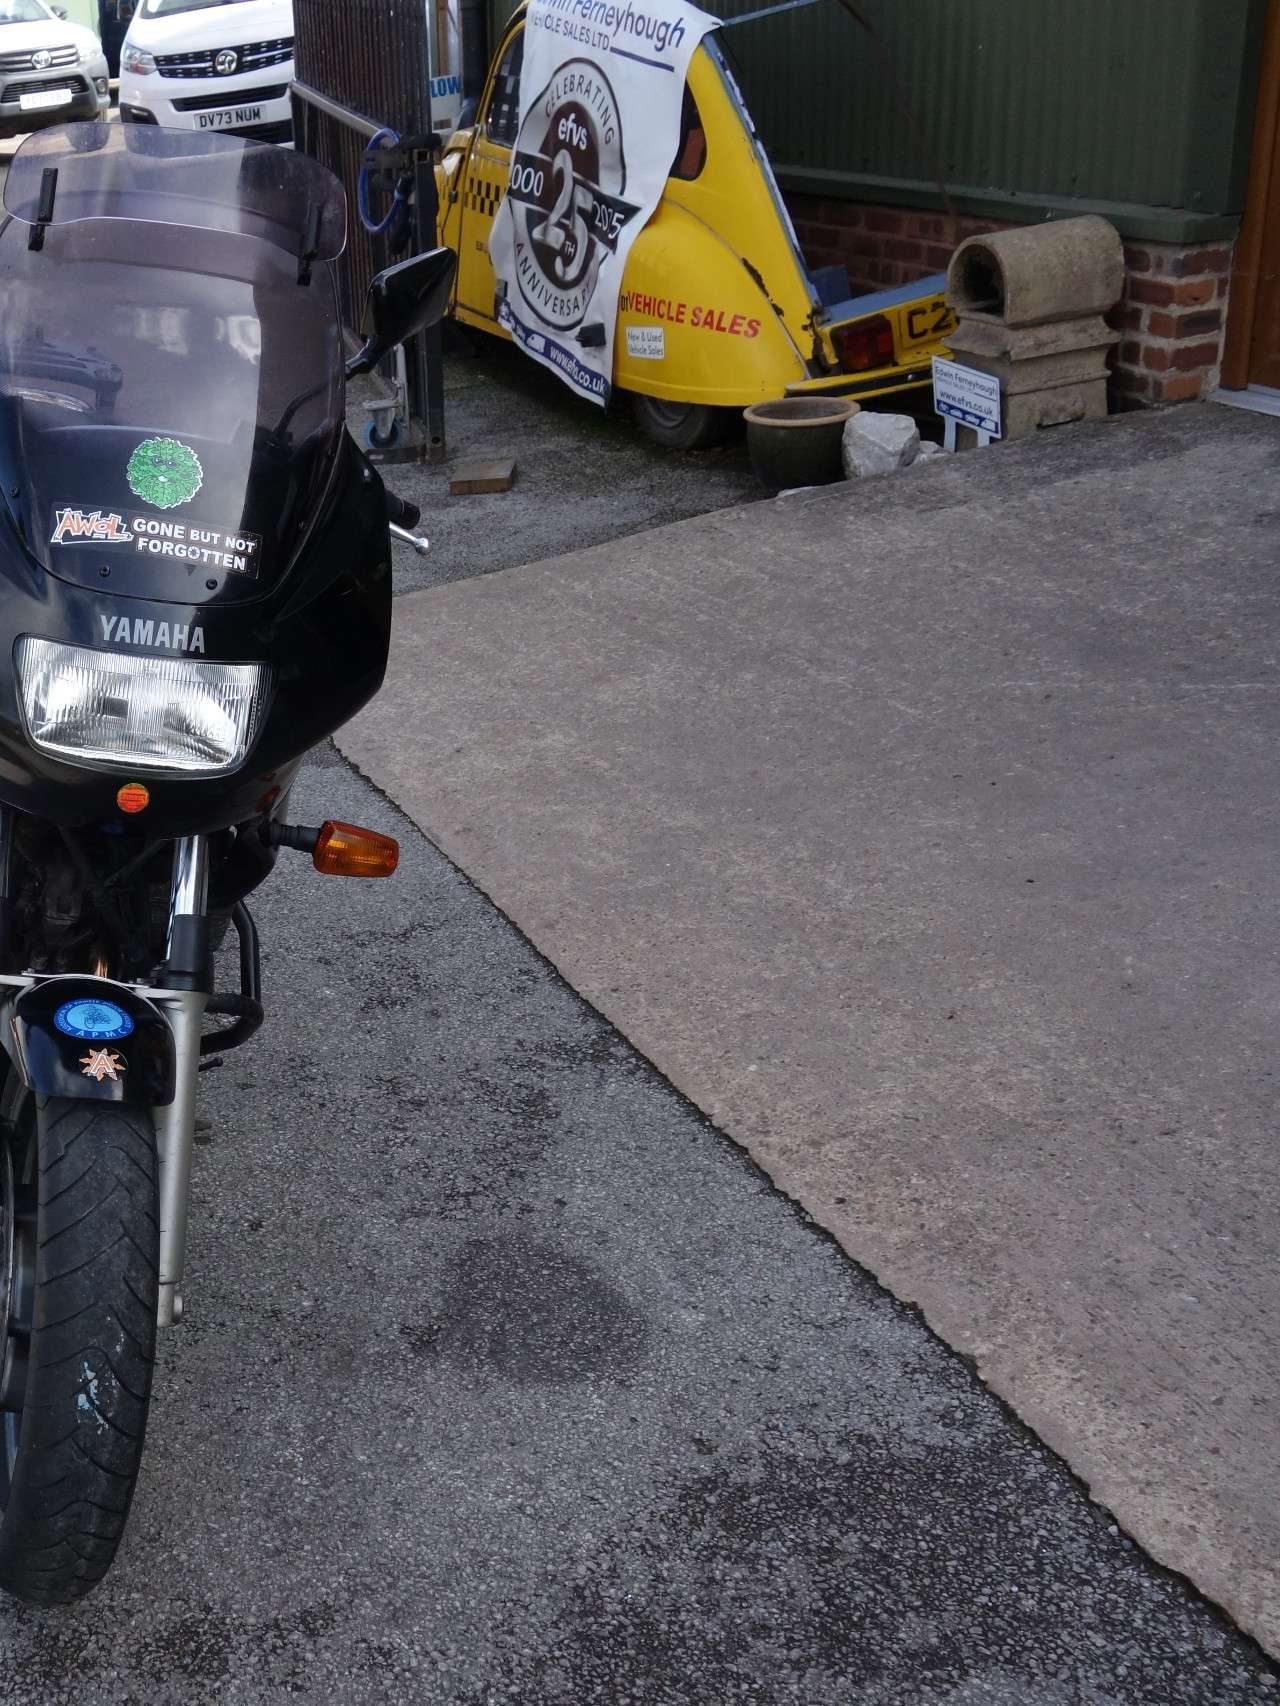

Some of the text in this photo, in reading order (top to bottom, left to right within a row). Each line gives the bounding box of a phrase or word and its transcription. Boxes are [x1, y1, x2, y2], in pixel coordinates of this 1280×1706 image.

[563, 20, 590, 44] SALES
[592, 31, 610, 50] LTD
[199, 107, 261, 128] DV73 NUM
[545, 74, 615, 145] CELEBRATING
[558, 113, 588, 150] efvs
[512, 164, 544, 197] 000
[564, 240, 576, 258] TH
[628, 290, 687, 324] VEHICLE
[690, 306, 762, 338] SALES
[940, 391, 993, 415] www.efvs.co.uk
[133, 518, 186, 540] GONE
[189, 529, 221, 545] BUT
[225, 536, 257, 553] NOT
[137, 538, 247, 571] FORGOTTEN
[100, 614, 206, 654] YAMAHA
